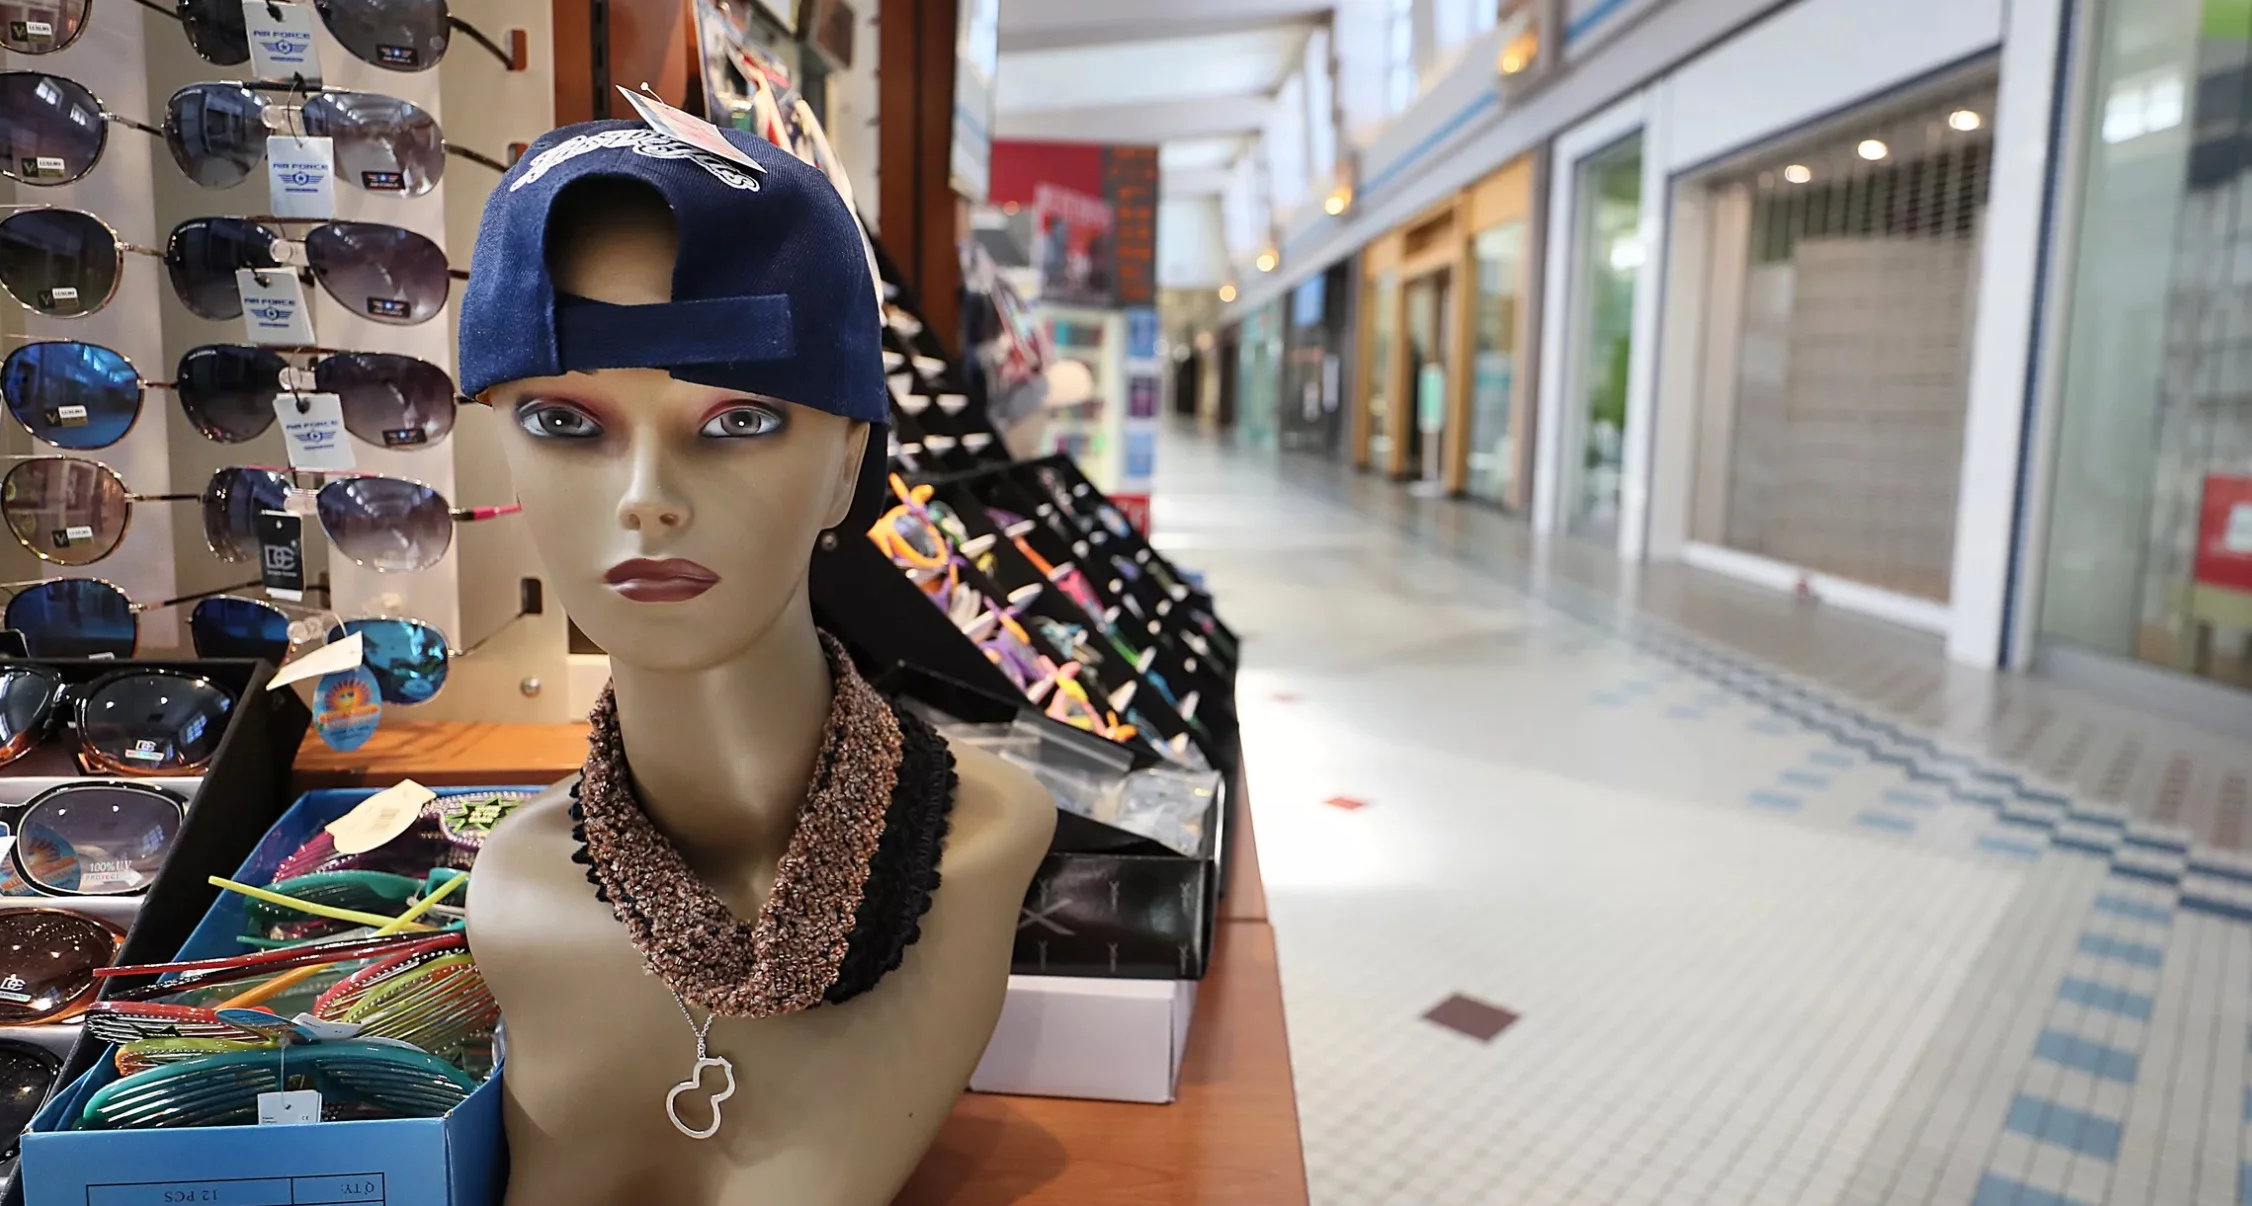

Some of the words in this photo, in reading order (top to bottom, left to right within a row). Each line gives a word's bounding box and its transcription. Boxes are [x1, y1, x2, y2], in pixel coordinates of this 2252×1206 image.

[272, 31, 311, 39] FORCE
[291, 163, 329, 171] FORCE
[261, 298, 296, 307] FORCE
[340, 1182, 375, 1195] QTY:
[164, 1190, 195, 1203] PCS
[202, 1189, 218, 1201] 12
